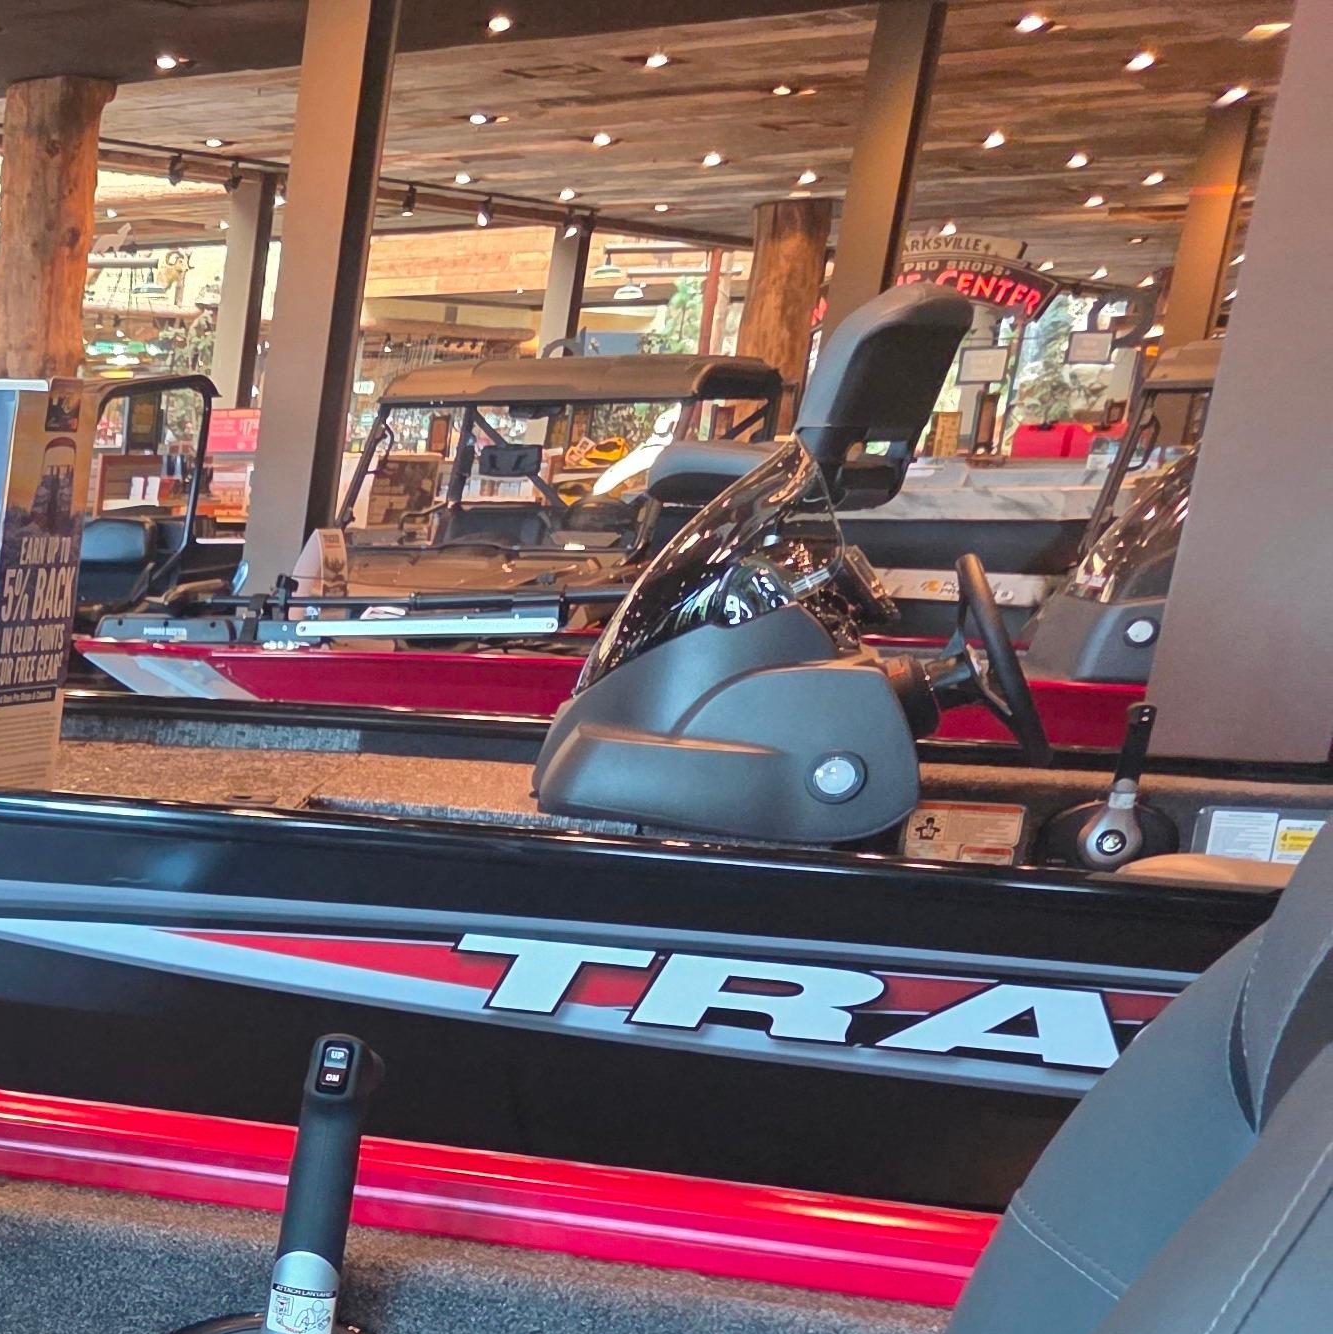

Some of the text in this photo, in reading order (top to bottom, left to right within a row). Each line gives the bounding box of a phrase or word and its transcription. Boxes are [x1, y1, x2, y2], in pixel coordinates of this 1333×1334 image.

[903, 260, 1004, 277] PRO SHOPS
[19, 536, 71, 566] EARN UP TO
[0, 566, 76, 622] 5% BACK
[0, 623, 66, 655] IN CLUB POINTS
[13, 655, 35, 684] FREE
[456, 932, 1120, 1068] TRA
[330, 1050, 346, 1060] UP
